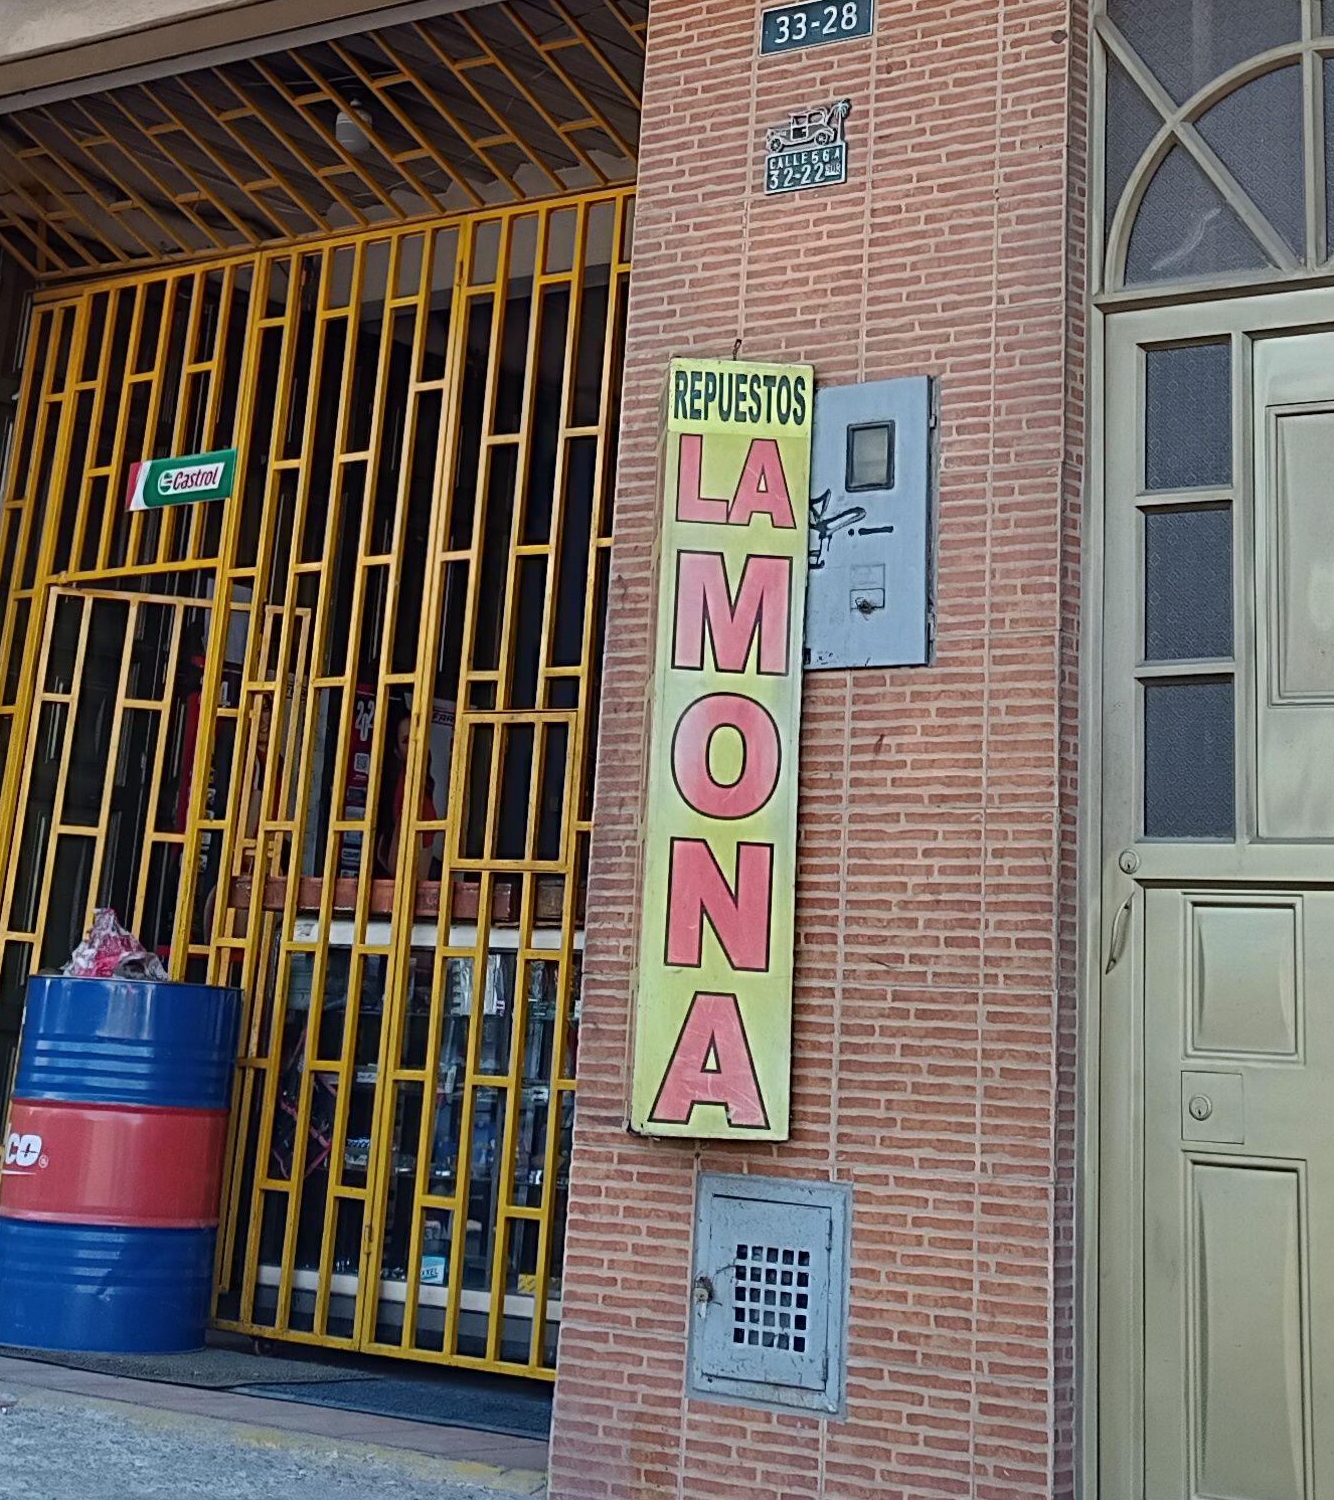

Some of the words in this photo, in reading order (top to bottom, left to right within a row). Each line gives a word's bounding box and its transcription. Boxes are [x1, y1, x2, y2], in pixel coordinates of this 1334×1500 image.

[774, 2, 858, 44] 33-28
[769, 151, 809, 171] CALLE
[769, 162, 825, 190] 32-22
[673, 370, 806, 426] REPUESTOS
[173, 466, 219, 491] Castrol
[675, 434, 798, 530] LA
[648, 548, 793, 1131] MONA
